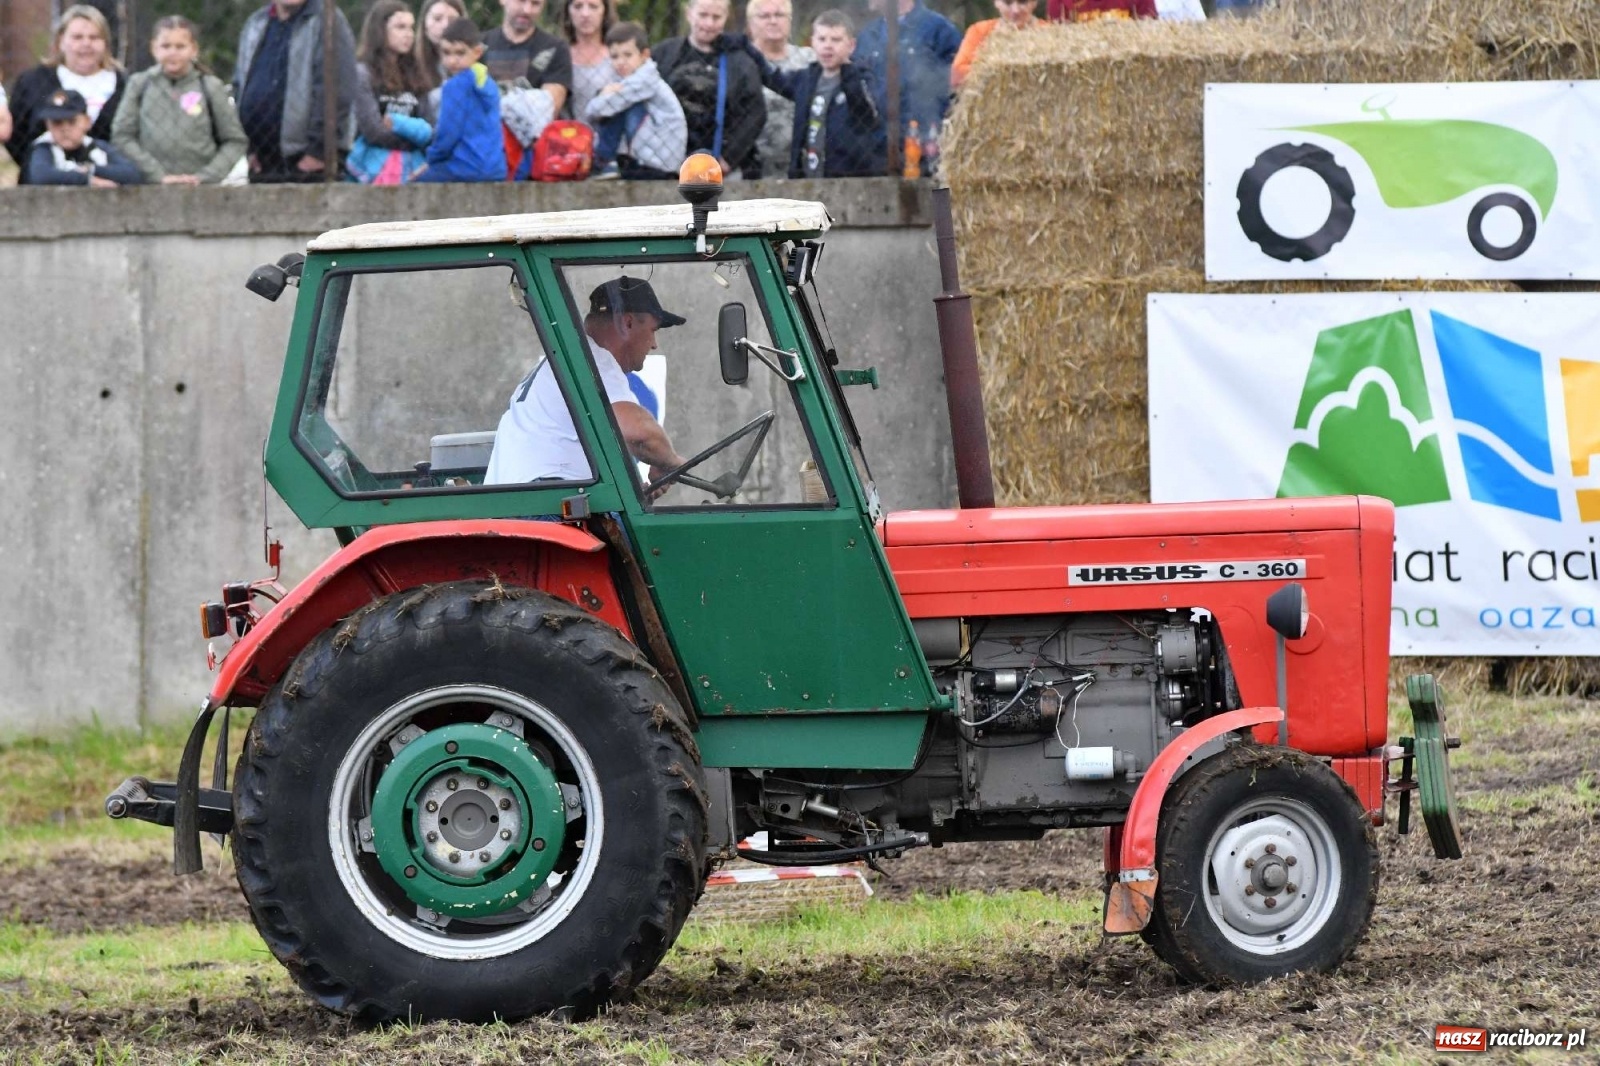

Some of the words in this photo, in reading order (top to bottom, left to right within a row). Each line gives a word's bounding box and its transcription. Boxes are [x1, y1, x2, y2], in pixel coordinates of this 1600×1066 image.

[1076, 564, 1208, 582] URSUS
[1257, 562, 1299, 577] 360
[1479, 607, 1596, 629] oaza
